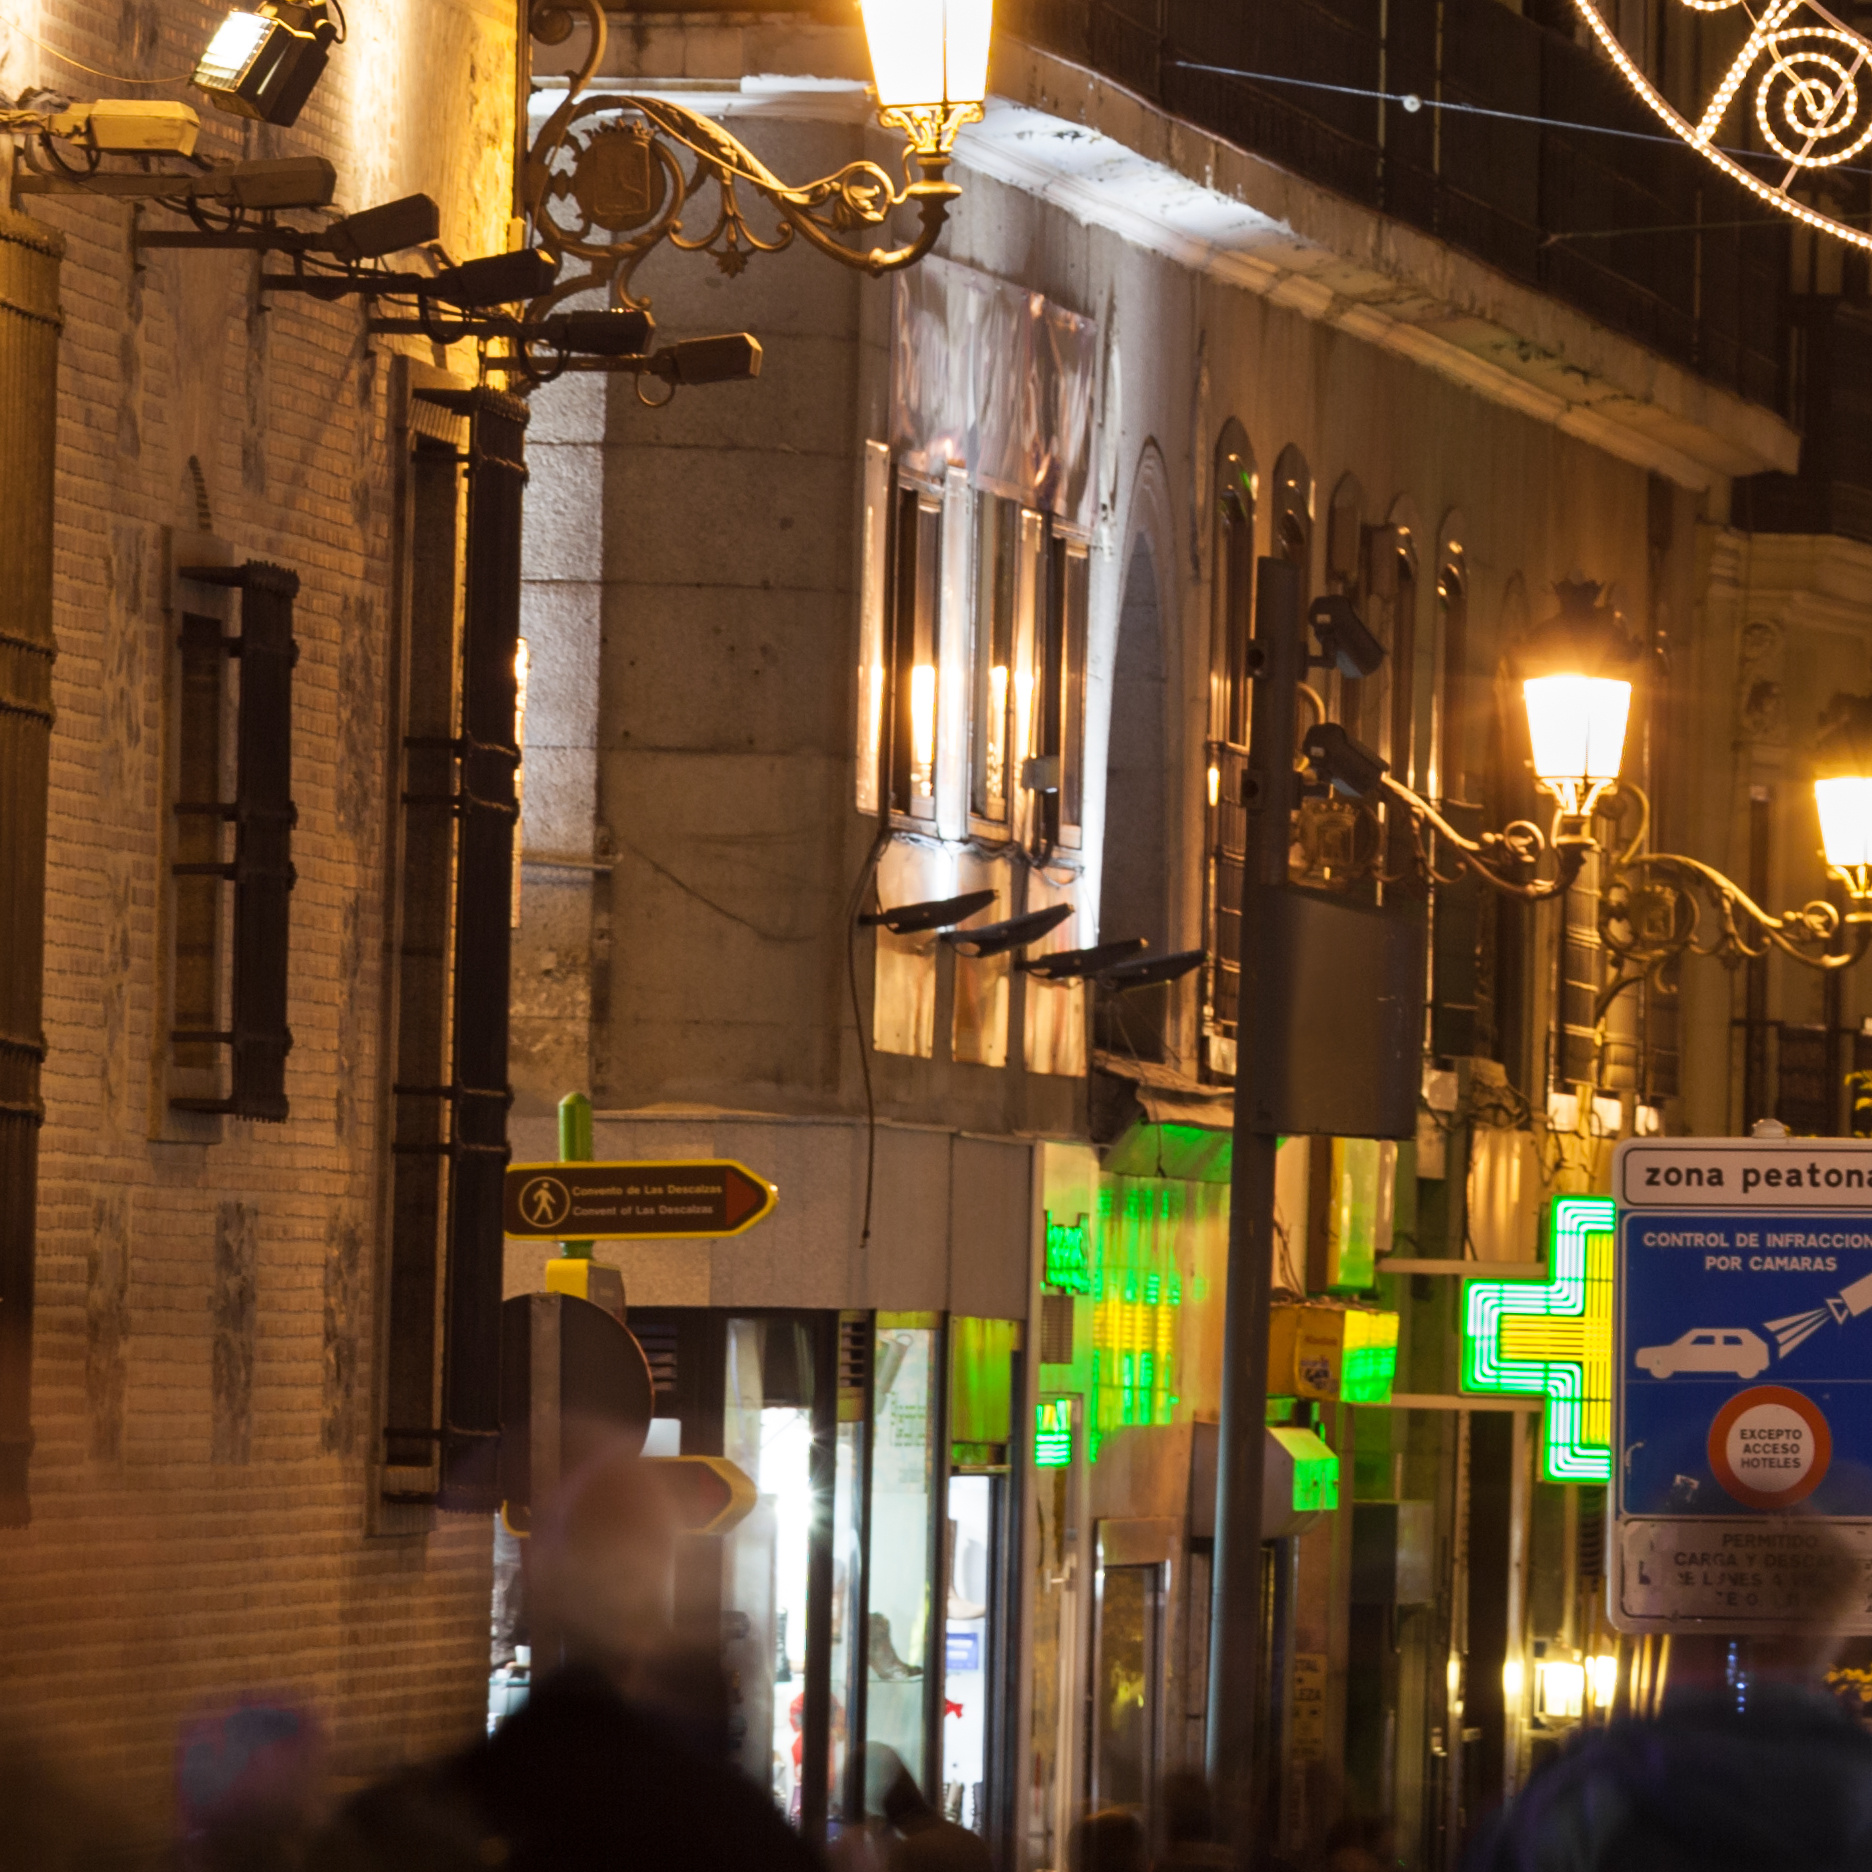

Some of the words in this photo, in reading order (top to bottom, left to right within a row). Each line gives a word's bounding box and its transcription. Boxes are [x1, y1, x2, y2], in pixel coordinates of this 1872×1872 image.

[1644, 1166, 1725, 1187] zona
[572, 1185, 622, 1197] Convento
[627, 1184, 640, 1195] de
[644, 1184, 663, 1195] Las
[667, 1184, 722, 1195] Descalzas
[572, 1206, 616, 1216] Convent
[620, 1205, 632, 1216] of
[636, 1205, 656, 1216] Las
[659, 1205, 713, 1215] Descalzas
[1643, 1232, 1729, 1248] CONTROL
[1735, 1232, 1760, 1248] DE
[1705, 1256, 1742, 1271] POR
[1749, 1256, 1837, 1271] CAMARAS
[1740, 1429, 1802, 1440] EXCEPTO
[1743, 1443, 1800, 1454] ACCESO
[1741, 1457, 1801, 1468] HOTELES
[1722, 1533, 1818, 1548] PERMITIDO
[1674, 1552, 1736, 1567] CARGA
[1745, 1554, 1756, 1566] Y
